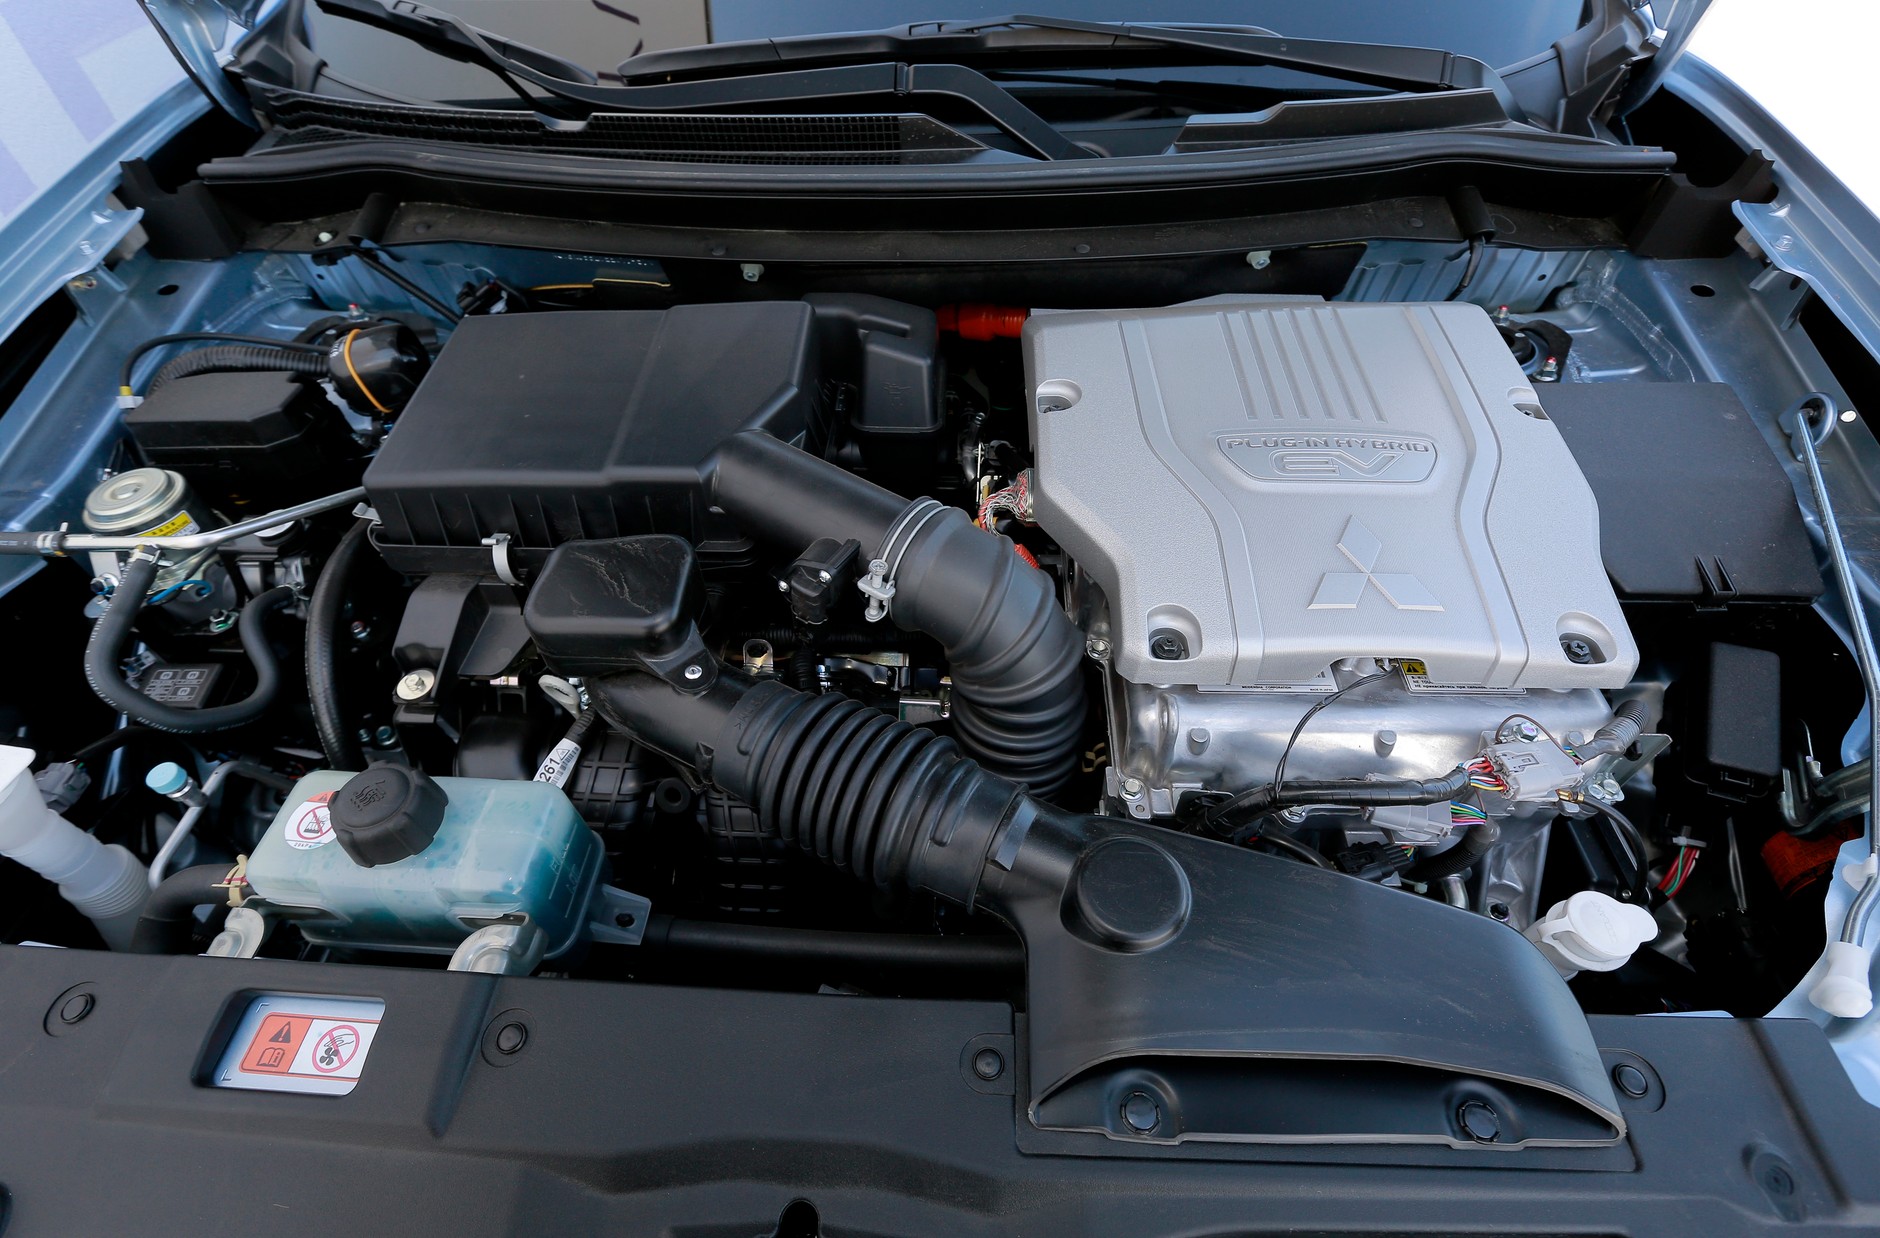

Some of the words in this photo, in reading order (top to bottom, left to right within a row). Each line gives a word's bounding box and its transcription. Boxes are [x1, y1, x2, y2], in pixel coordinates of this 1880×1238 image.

[1226, 437, 1329, 450] PLUG-IN
[1335, 437, 1430, 453] HYBRID
[1270, 449, 1404, 478] EV
[537, 757, 561, 782] 261
